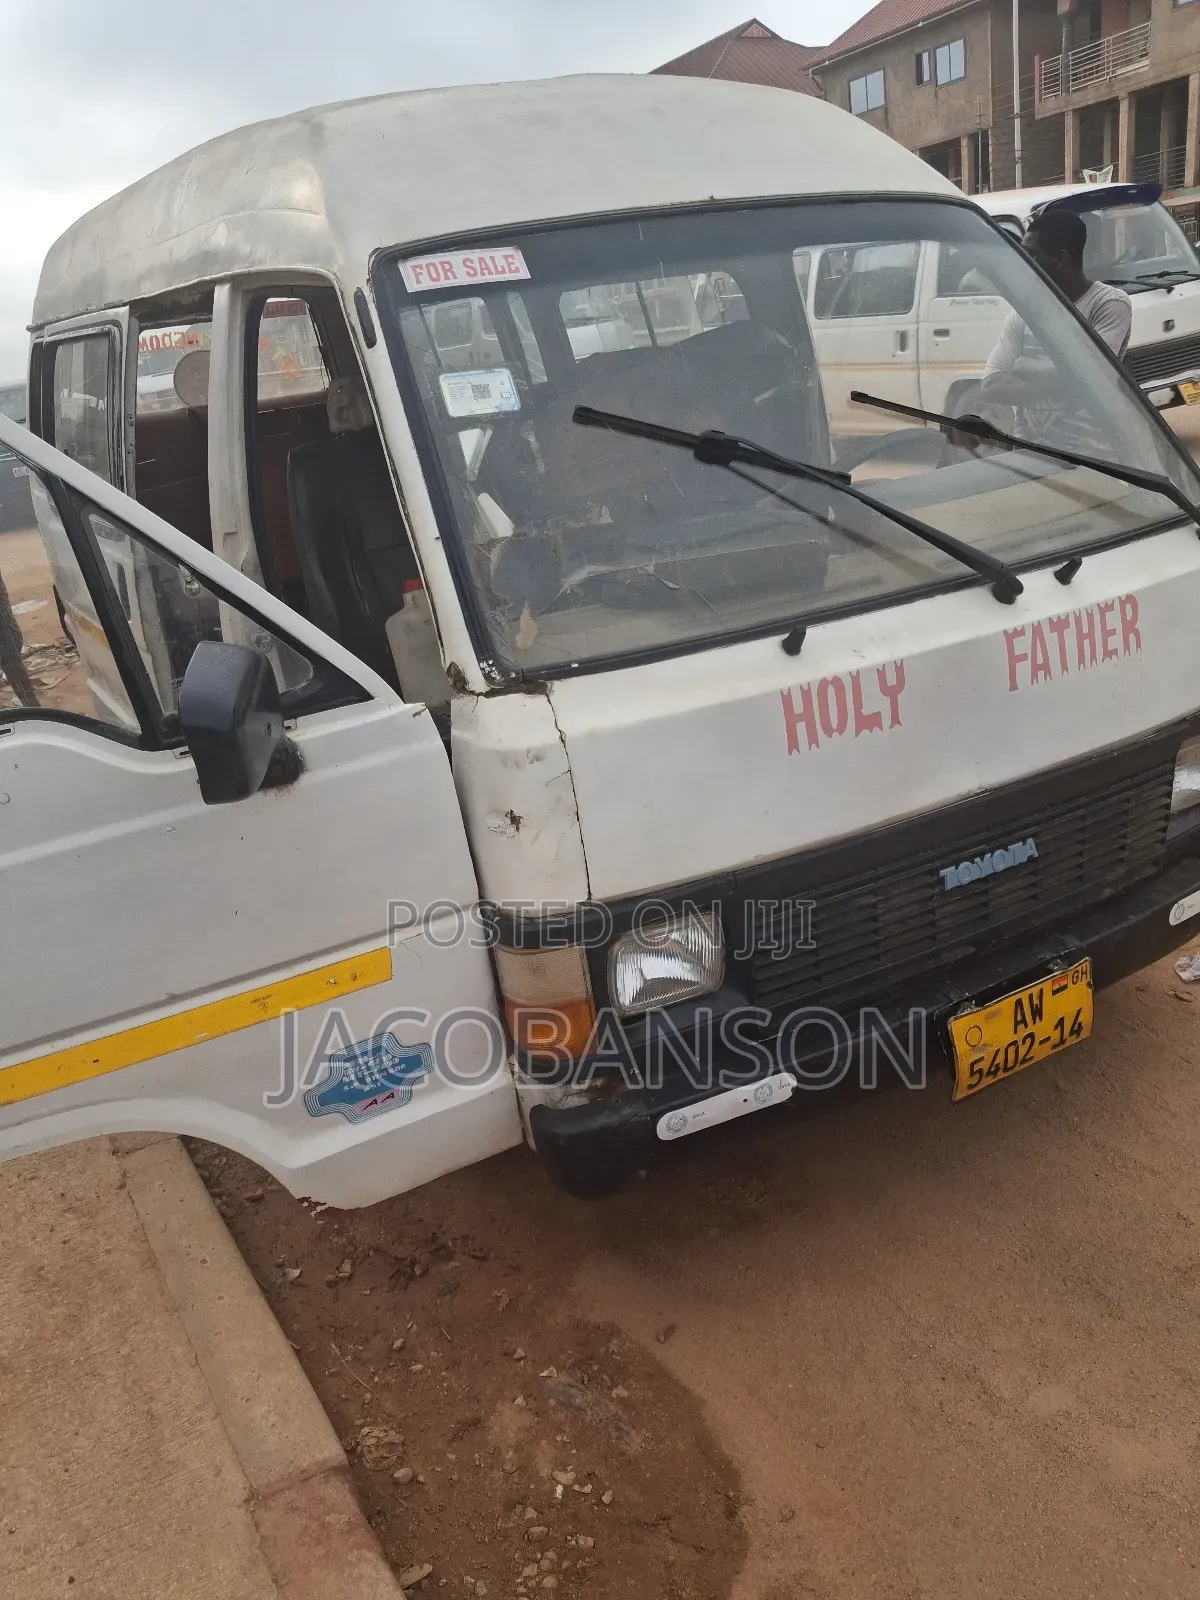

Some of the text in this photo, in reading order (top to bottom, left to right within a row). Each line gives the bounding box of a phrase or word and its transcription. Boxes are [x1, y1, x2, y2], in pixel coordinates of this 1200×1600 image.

[410, 254, 521, 285] FOR SALE
[780, 593, 1142, 756] HOLY FATHER
[940, 838, 1039, 892] TOYOTA
[1071, 963, 1088, 986] GH
[1013, 988, 1044, 1034] AW
[967, 1007, 1084, 1090] 5402-14
